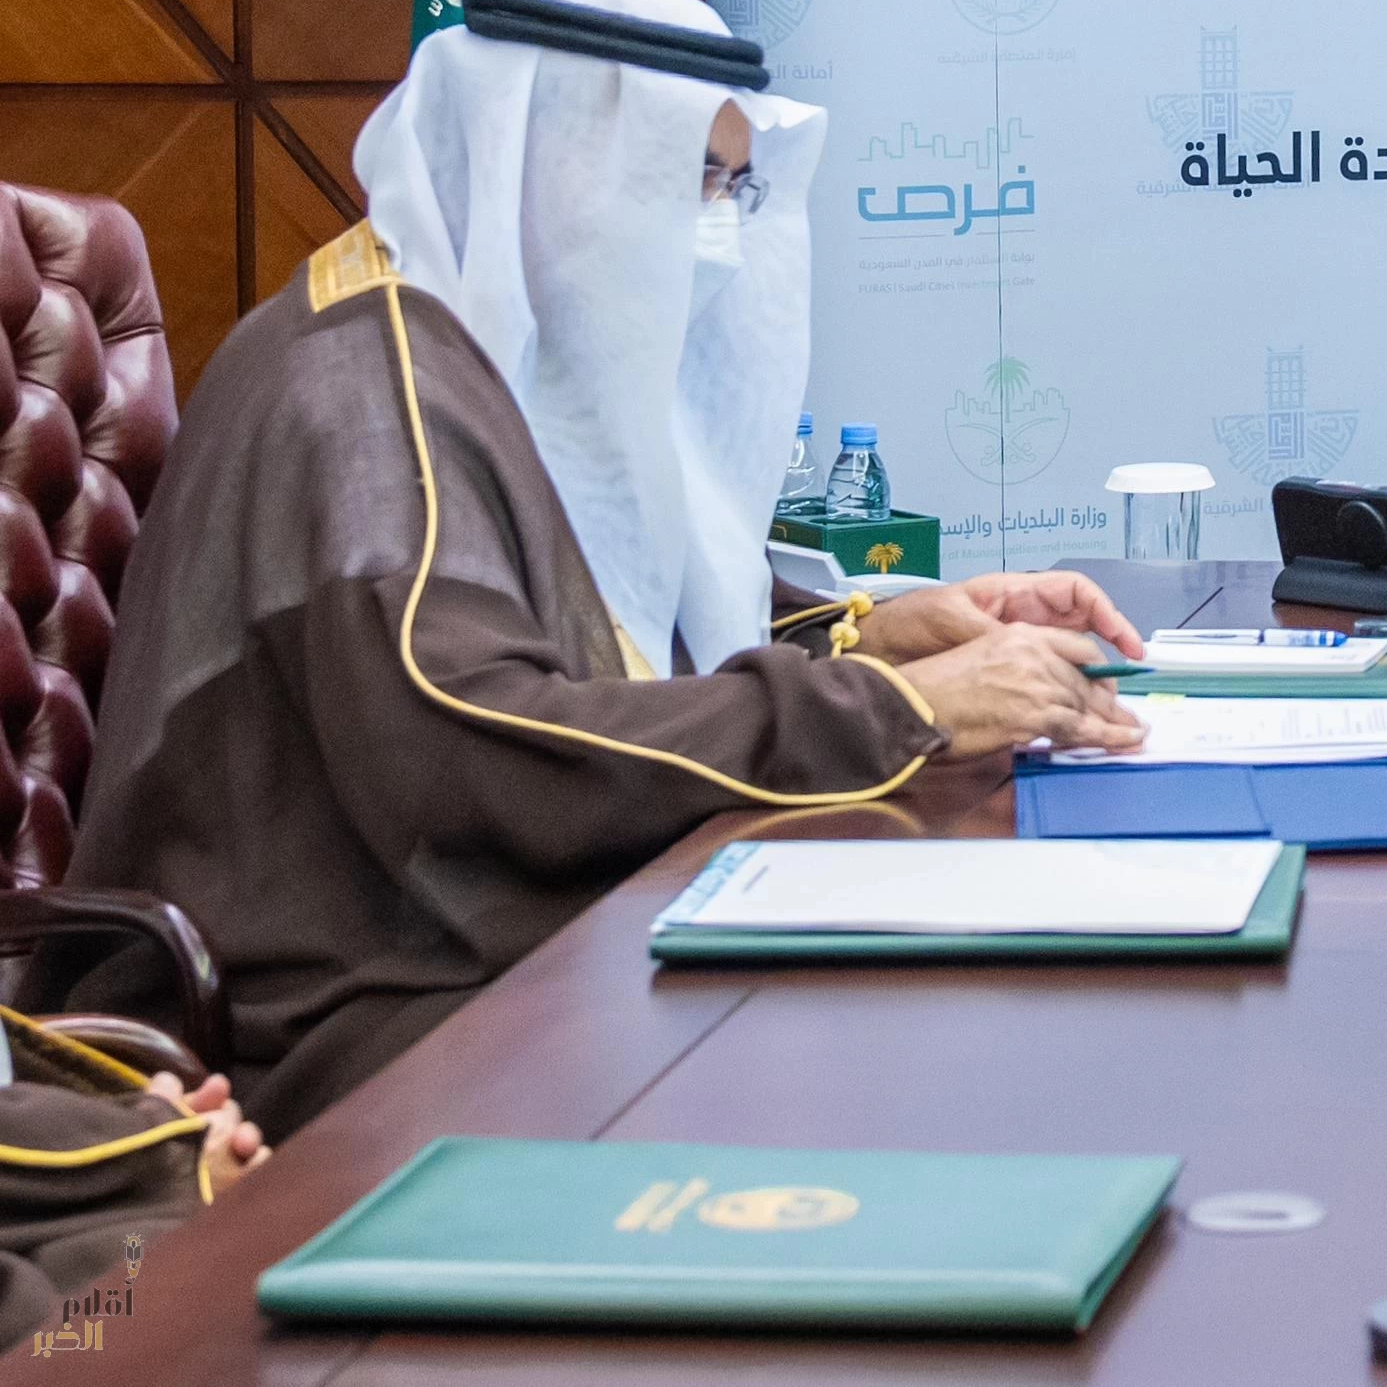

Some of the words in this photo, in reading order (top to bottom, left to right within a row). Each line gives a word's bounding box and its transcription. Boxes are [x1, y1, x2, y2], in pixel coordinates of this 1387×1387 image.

[791, 59, 833, 80] أمانة
[1180, 130, 1320, 198] الحياة
[857, 164, 1036, 236] فرص
[998, 507, 1065, 533] البلديات
[1070, 505, 1107, 529] وزارة
[1203, 497, 1264, 518] الشرقية
[940, 514, 992, 540] والإس
